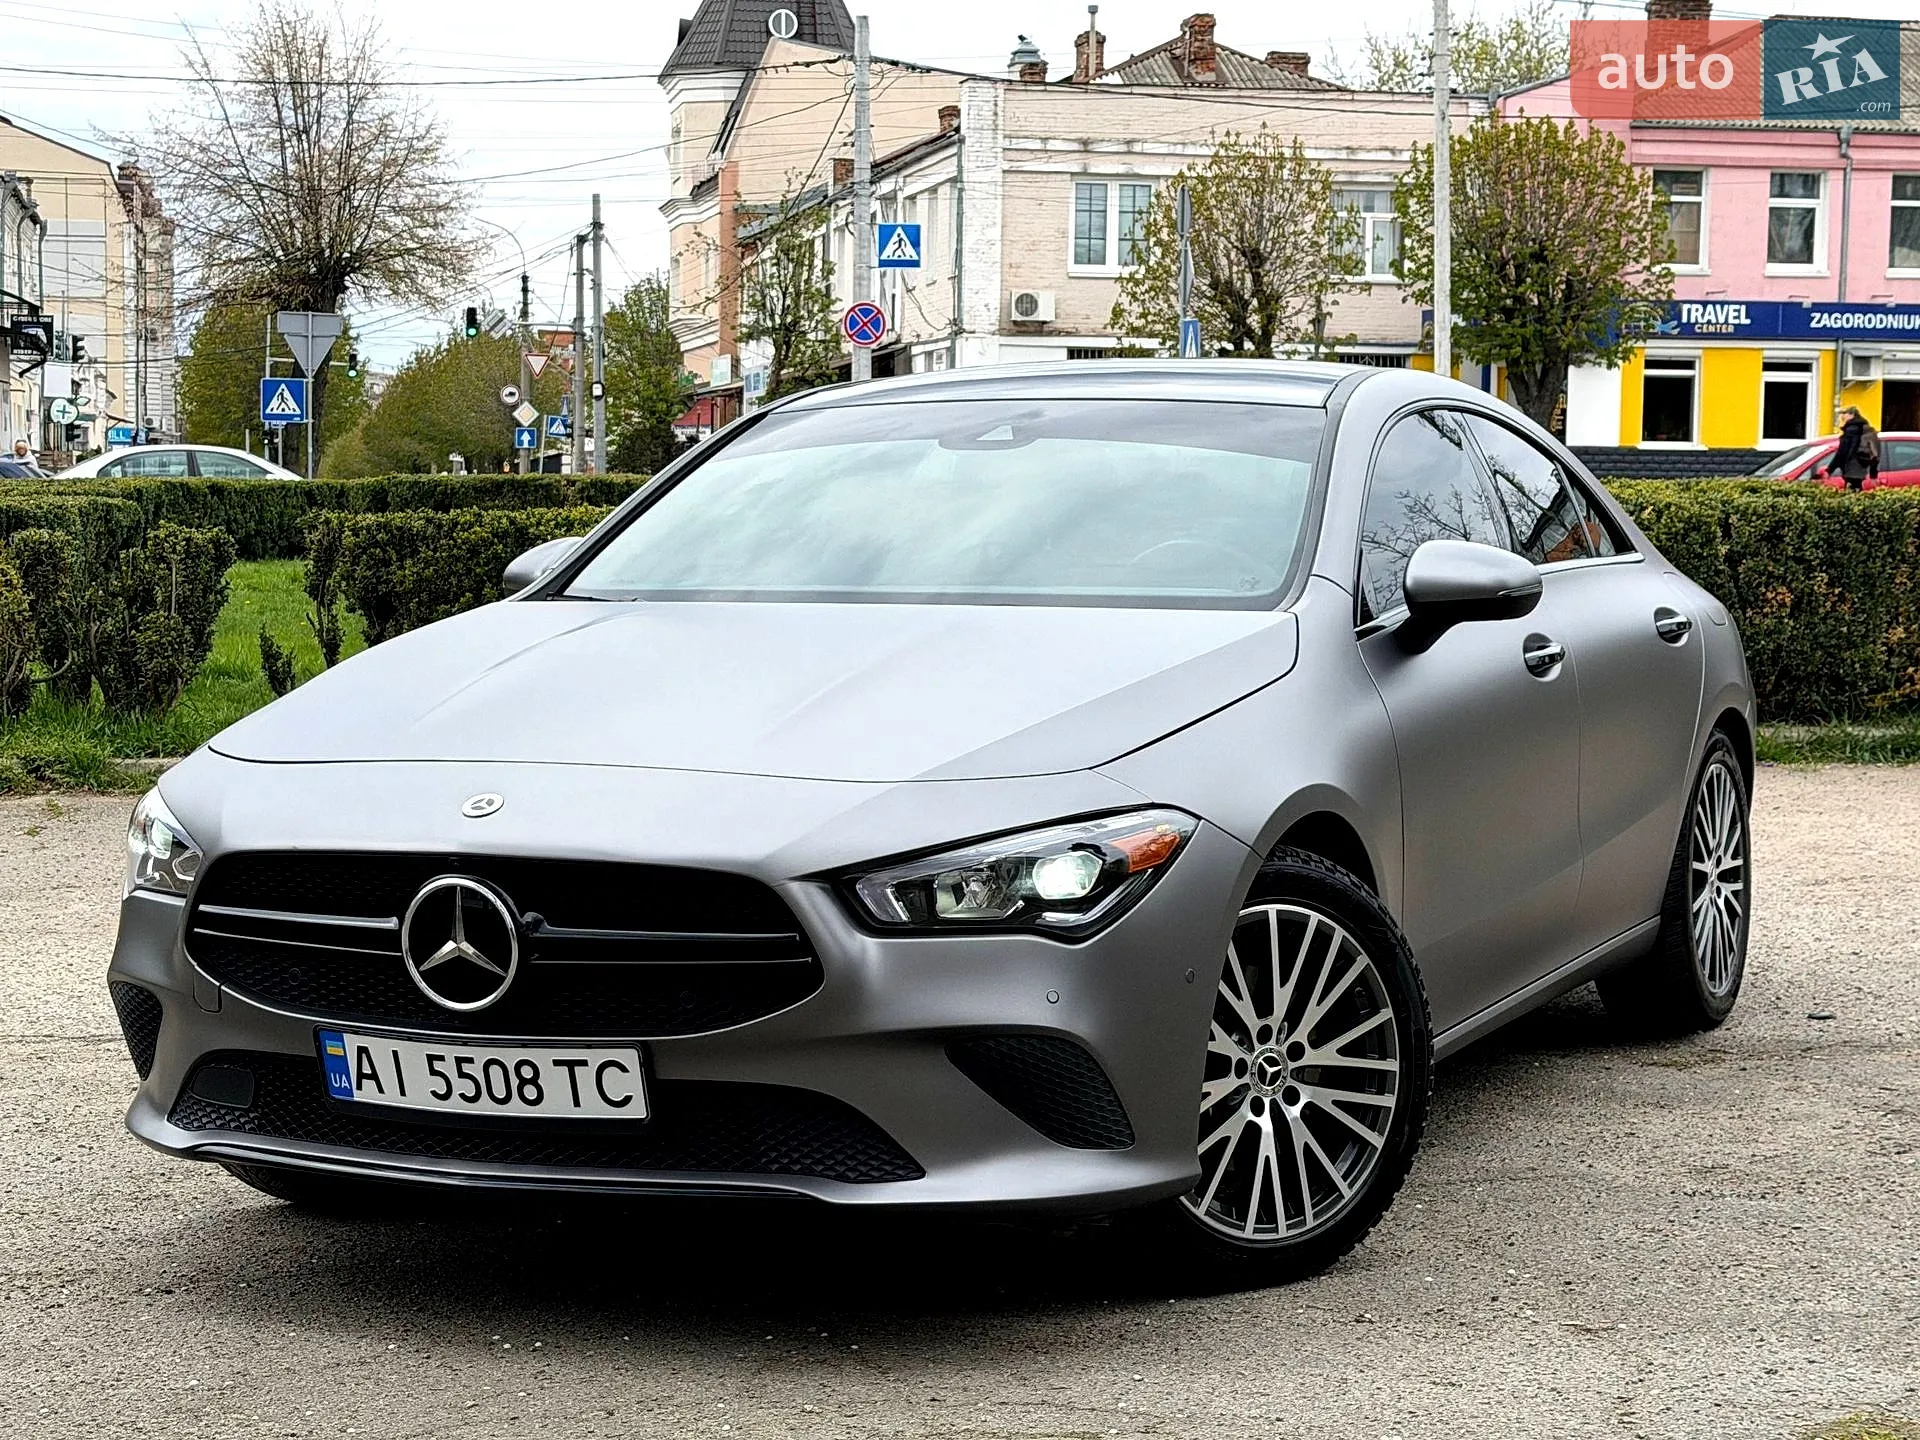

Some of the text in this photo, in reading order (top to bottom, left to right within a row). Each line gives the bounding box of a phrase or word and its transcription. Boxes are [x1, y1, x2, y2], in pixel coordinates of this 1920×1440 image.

[1681, 303, 1751, 325] TRAVEL
[1694, 324, 1735, 334] CENTER
[331, 1073, 350, 1090] UA
[355, 1044, 634, 1109] AI 5508 TC
